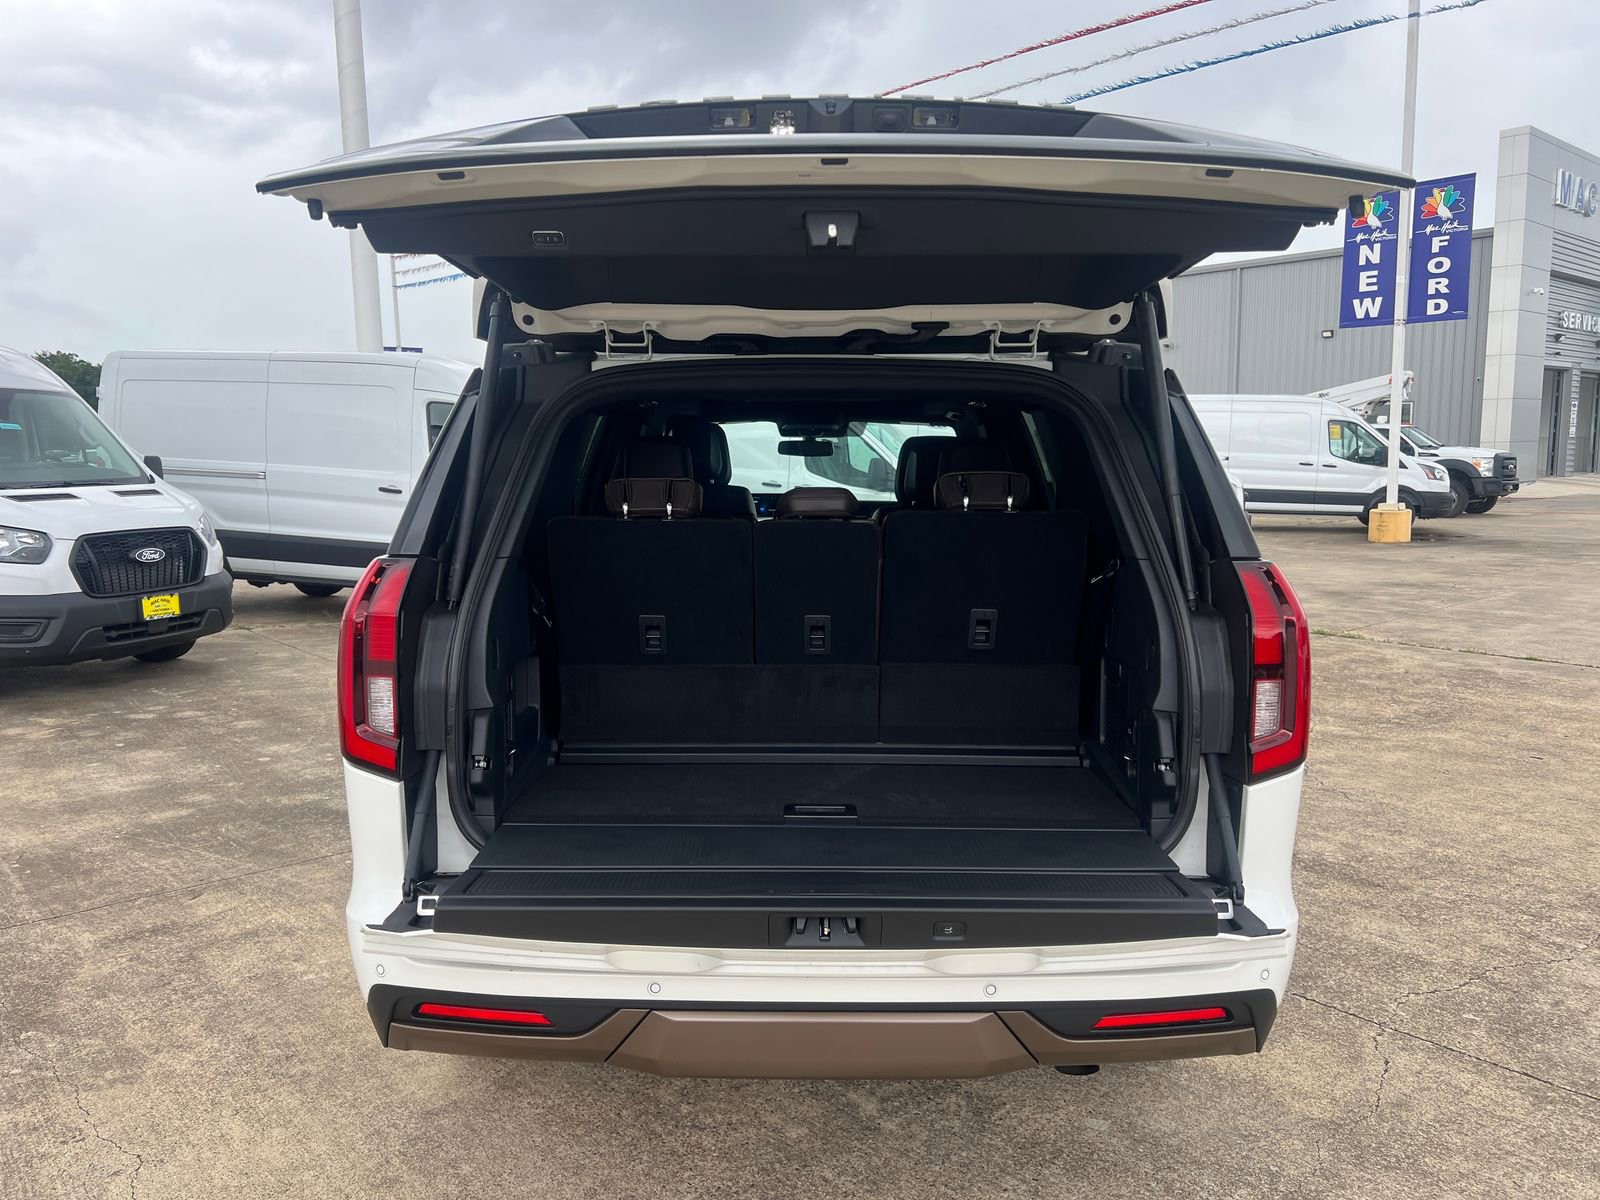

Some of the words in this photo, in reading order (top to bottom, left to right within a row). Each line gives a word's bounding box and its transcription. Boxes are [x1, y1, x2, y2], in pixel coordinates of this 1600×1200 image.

[1555, 168, 1599, 217] MAC
[1352, 243, 1383, 319] NEW
[1426, 235, 1451, 316] FORD
[141, 551, 160, 560] Ford
